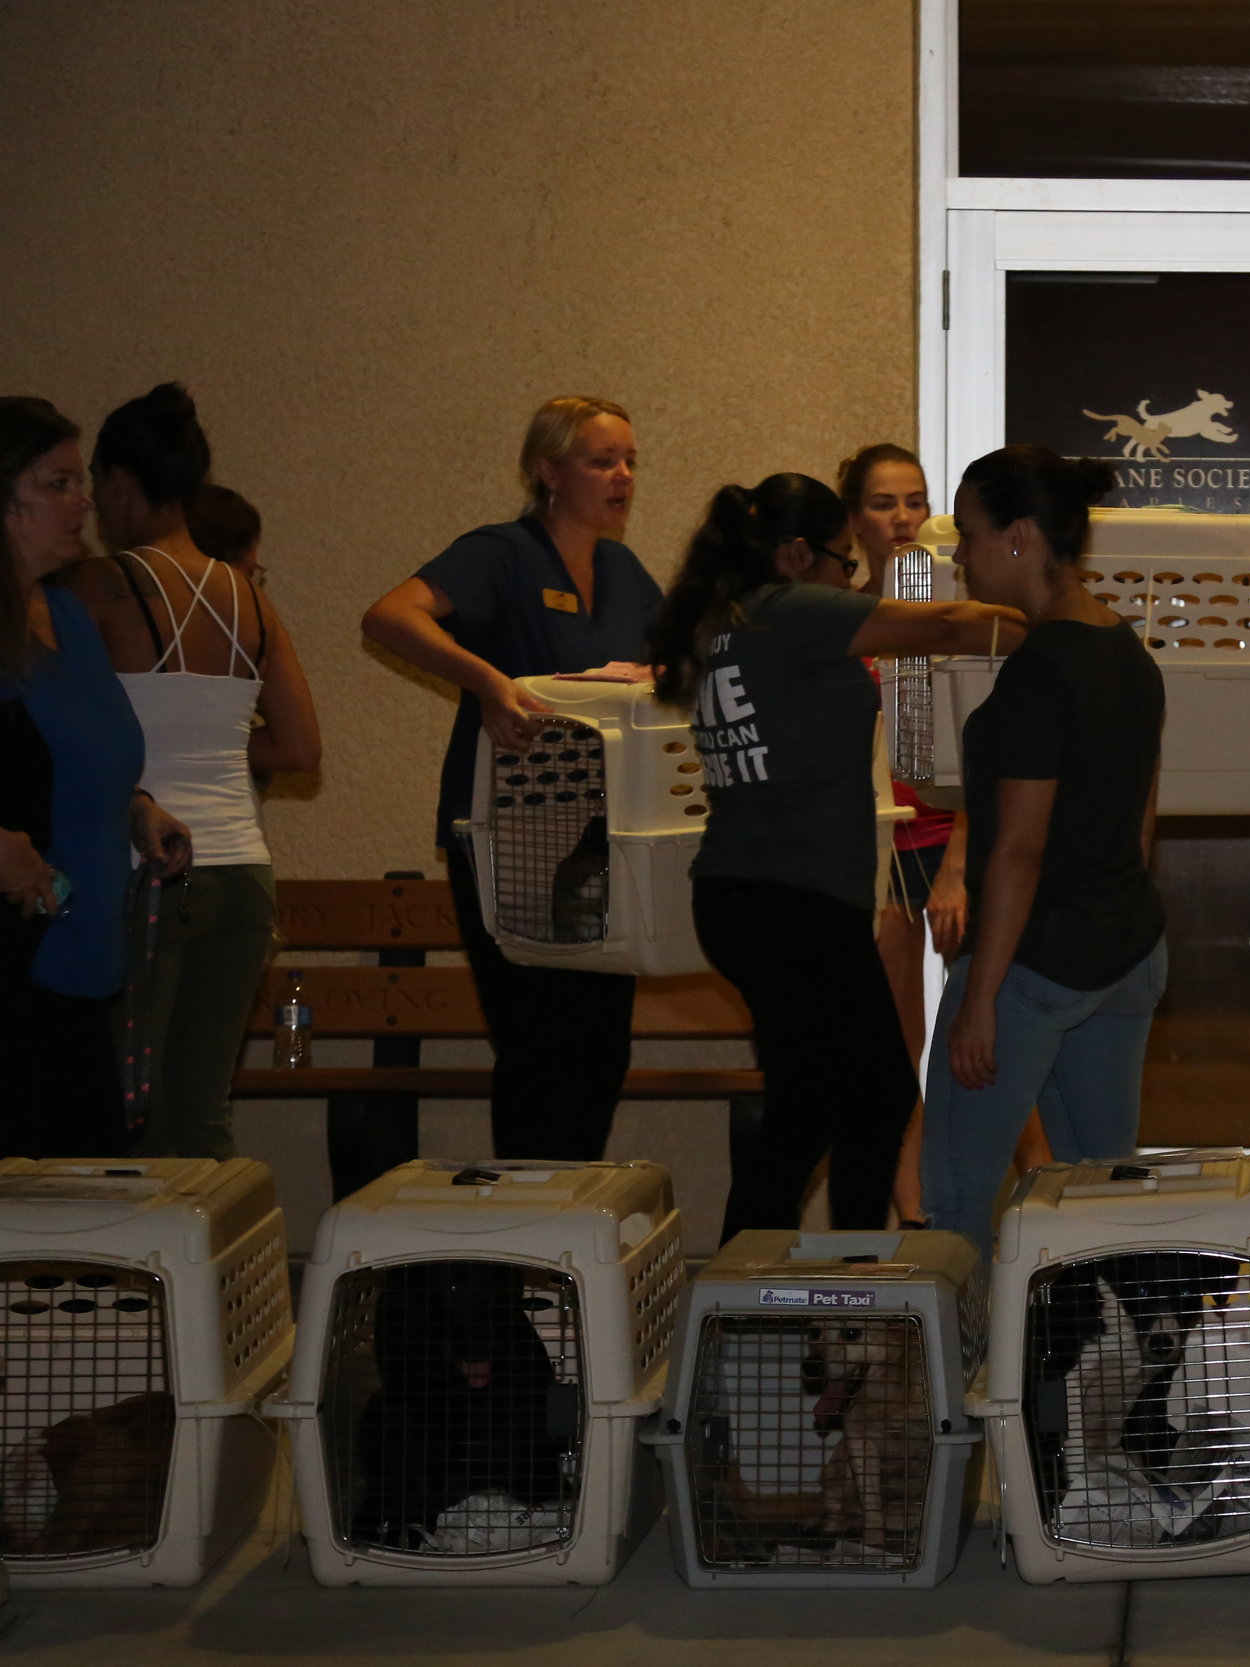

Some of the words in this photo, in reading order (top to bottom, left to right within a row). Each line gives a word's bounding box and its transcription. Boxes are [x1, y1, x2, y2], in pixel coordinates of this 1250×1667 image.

[1113, 468, 1163, 488] ANE
[1119, 497, 1243, 509] APES
[710, 632, 732, 656] UY
[716, 723, 760, 748] CAN
[736, 746, 769, 782] IT
[367, 904, 456, 934] JACK
[324, 988, 447, 1011] OVING
[774, 1296, 806, 1304] Petmate
[813, 1293, 838, 1305] Pet
[841, 1294, 871, 1306] Taxi
